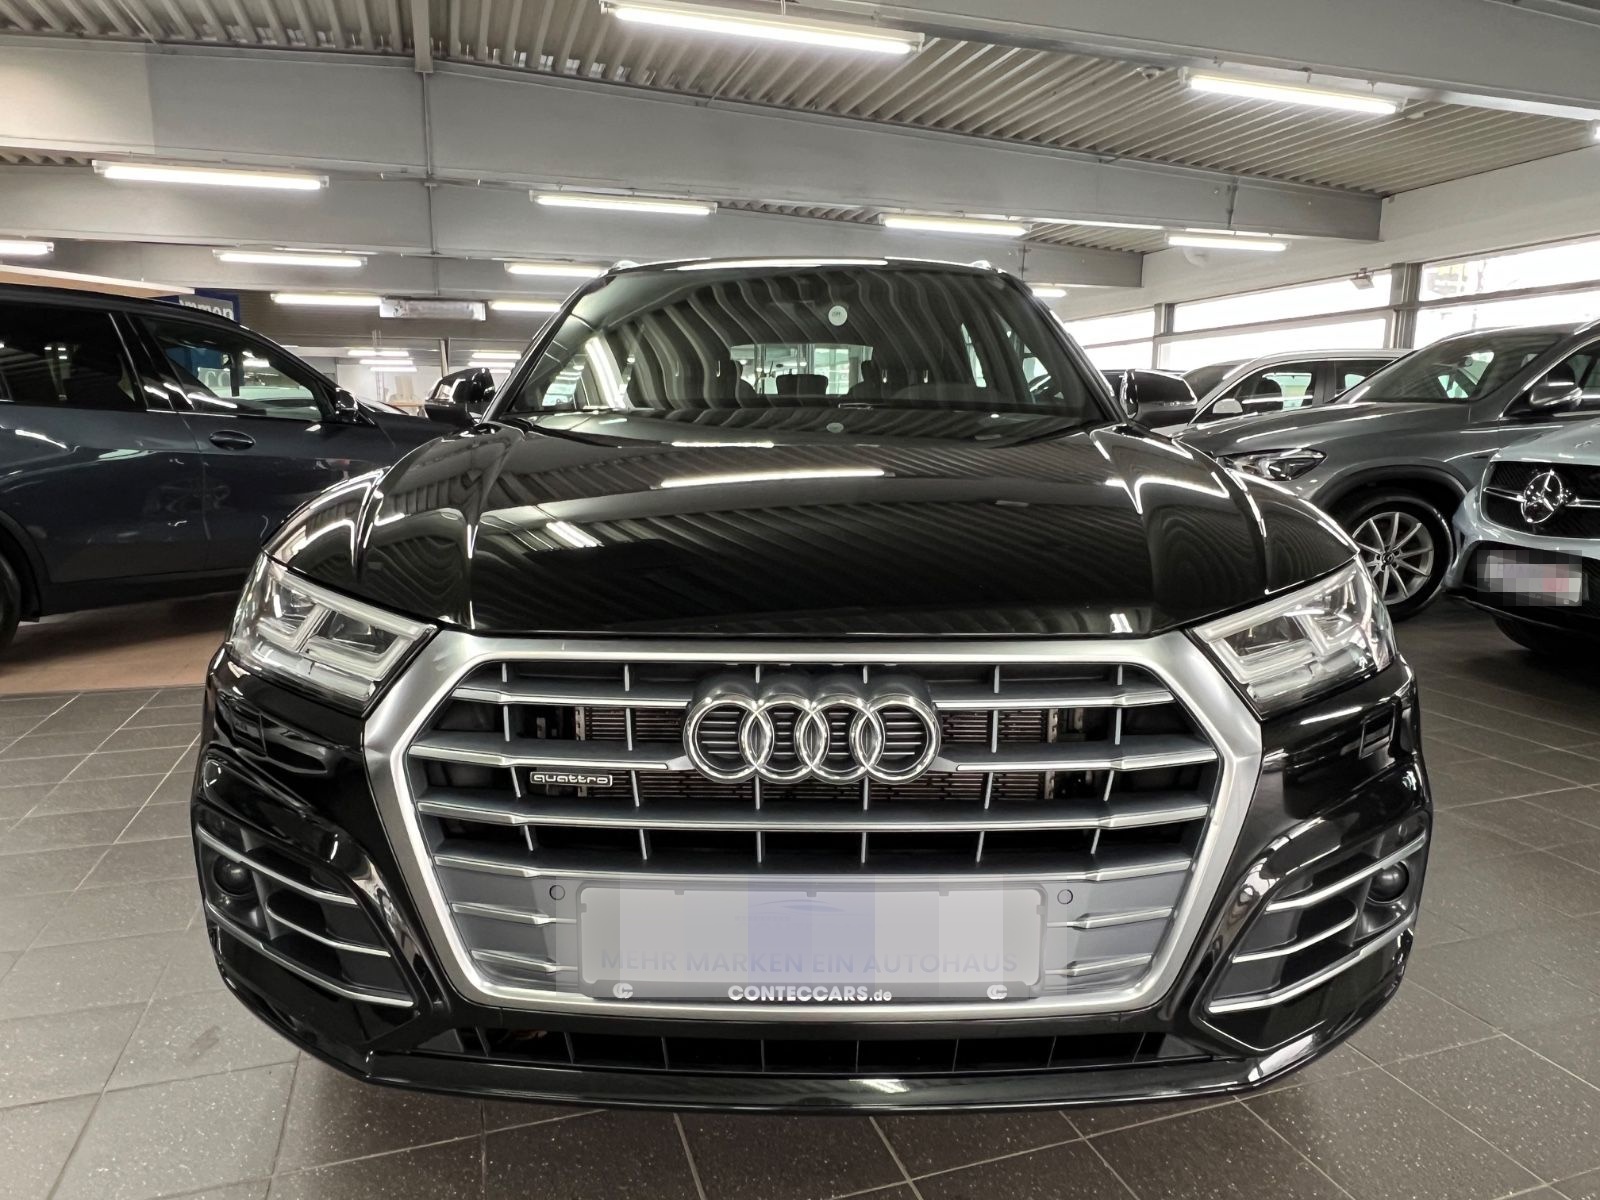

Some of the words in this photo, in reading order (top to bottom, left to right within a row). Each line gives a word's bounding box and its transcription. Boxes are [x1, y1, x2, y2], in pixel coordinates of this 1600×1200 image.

[533, 774, 609, 783] quattro
[601, 950, 678, 971] MEHR
[686, 951, 803, 973] MARKEN
[812, 953, 854, 973] EIN
[862, 952, 1018, 974] AUTOHAUS
[727, 985, 892, 1001] CONTECCARS.de
